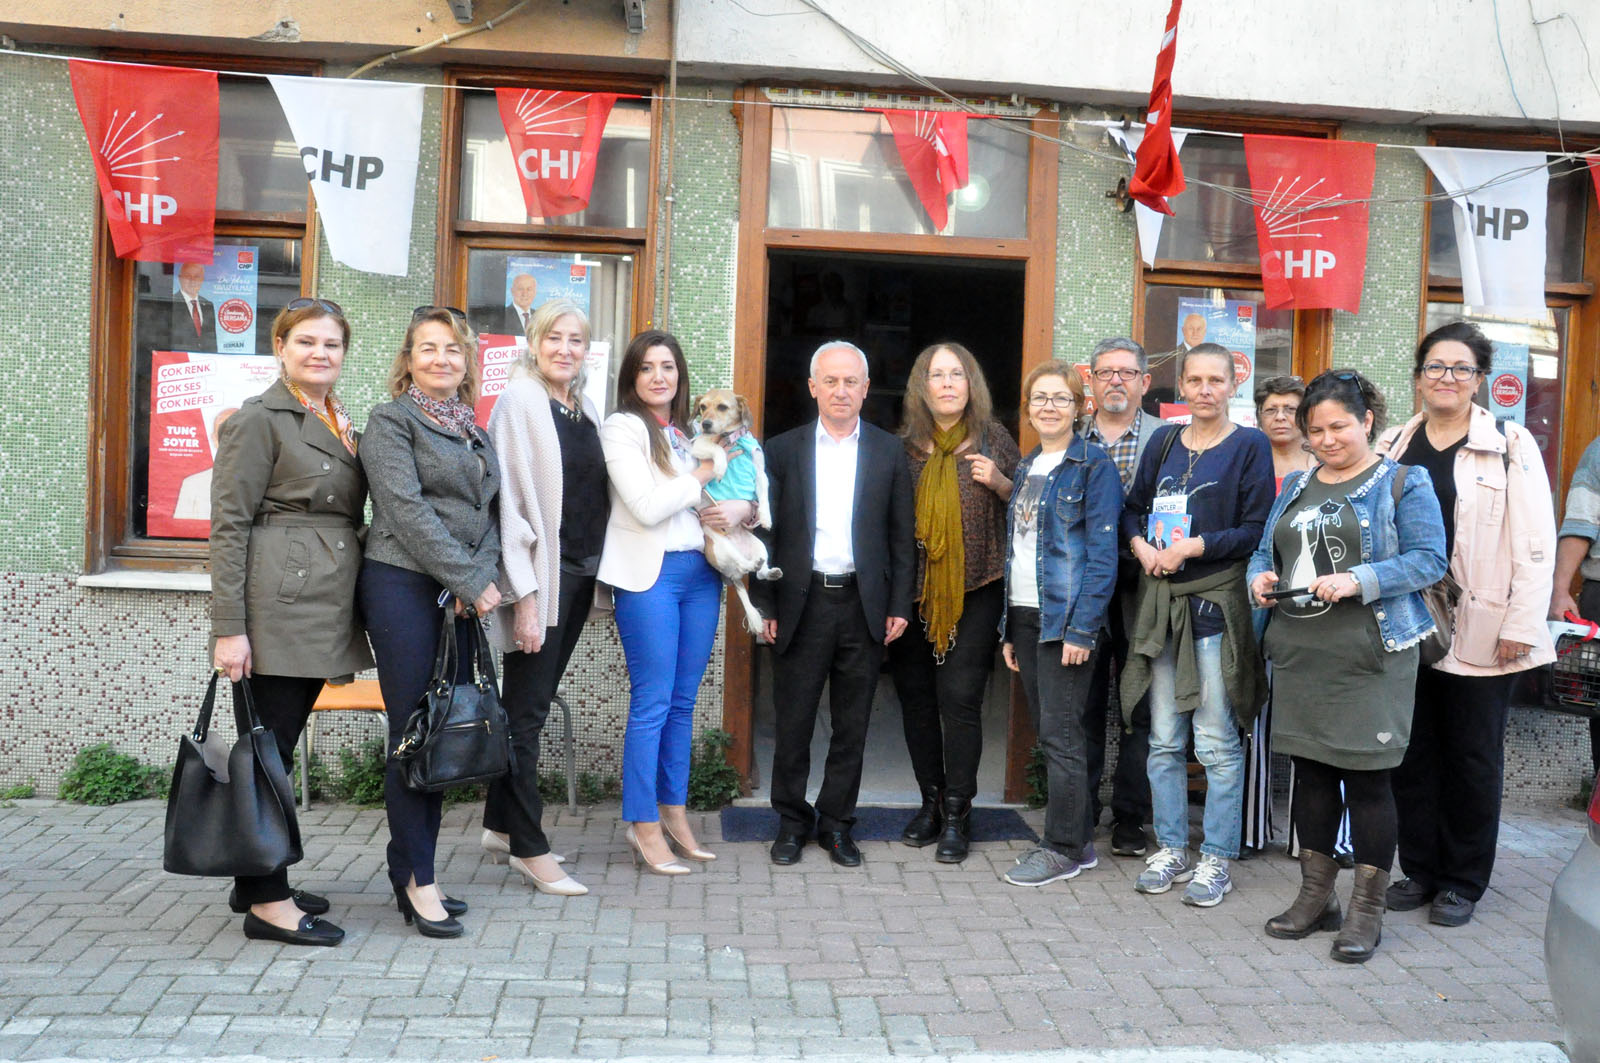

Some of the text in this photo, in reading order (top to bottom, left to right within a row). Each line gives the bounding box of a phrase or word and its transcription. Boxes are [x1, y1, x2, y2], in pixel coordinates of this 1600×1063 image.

[300, 146, 384, 190] CHP
[1467, 202, 1529, 240] HP
[487, 350, 509, 361] ÇOK
[161, 363, 211, 378] ÇOK RENK
[485, 368, 508, 380] ÇOK
[160, 381, 201, 395] ÇOK SES
[484, 382, 506, 394] ÇOK
[159, 395, 214, 410] ÇOK NEFES
[166, 425, 197, 437] TUNÇ
[163, 438, 199, 448] SOYER
